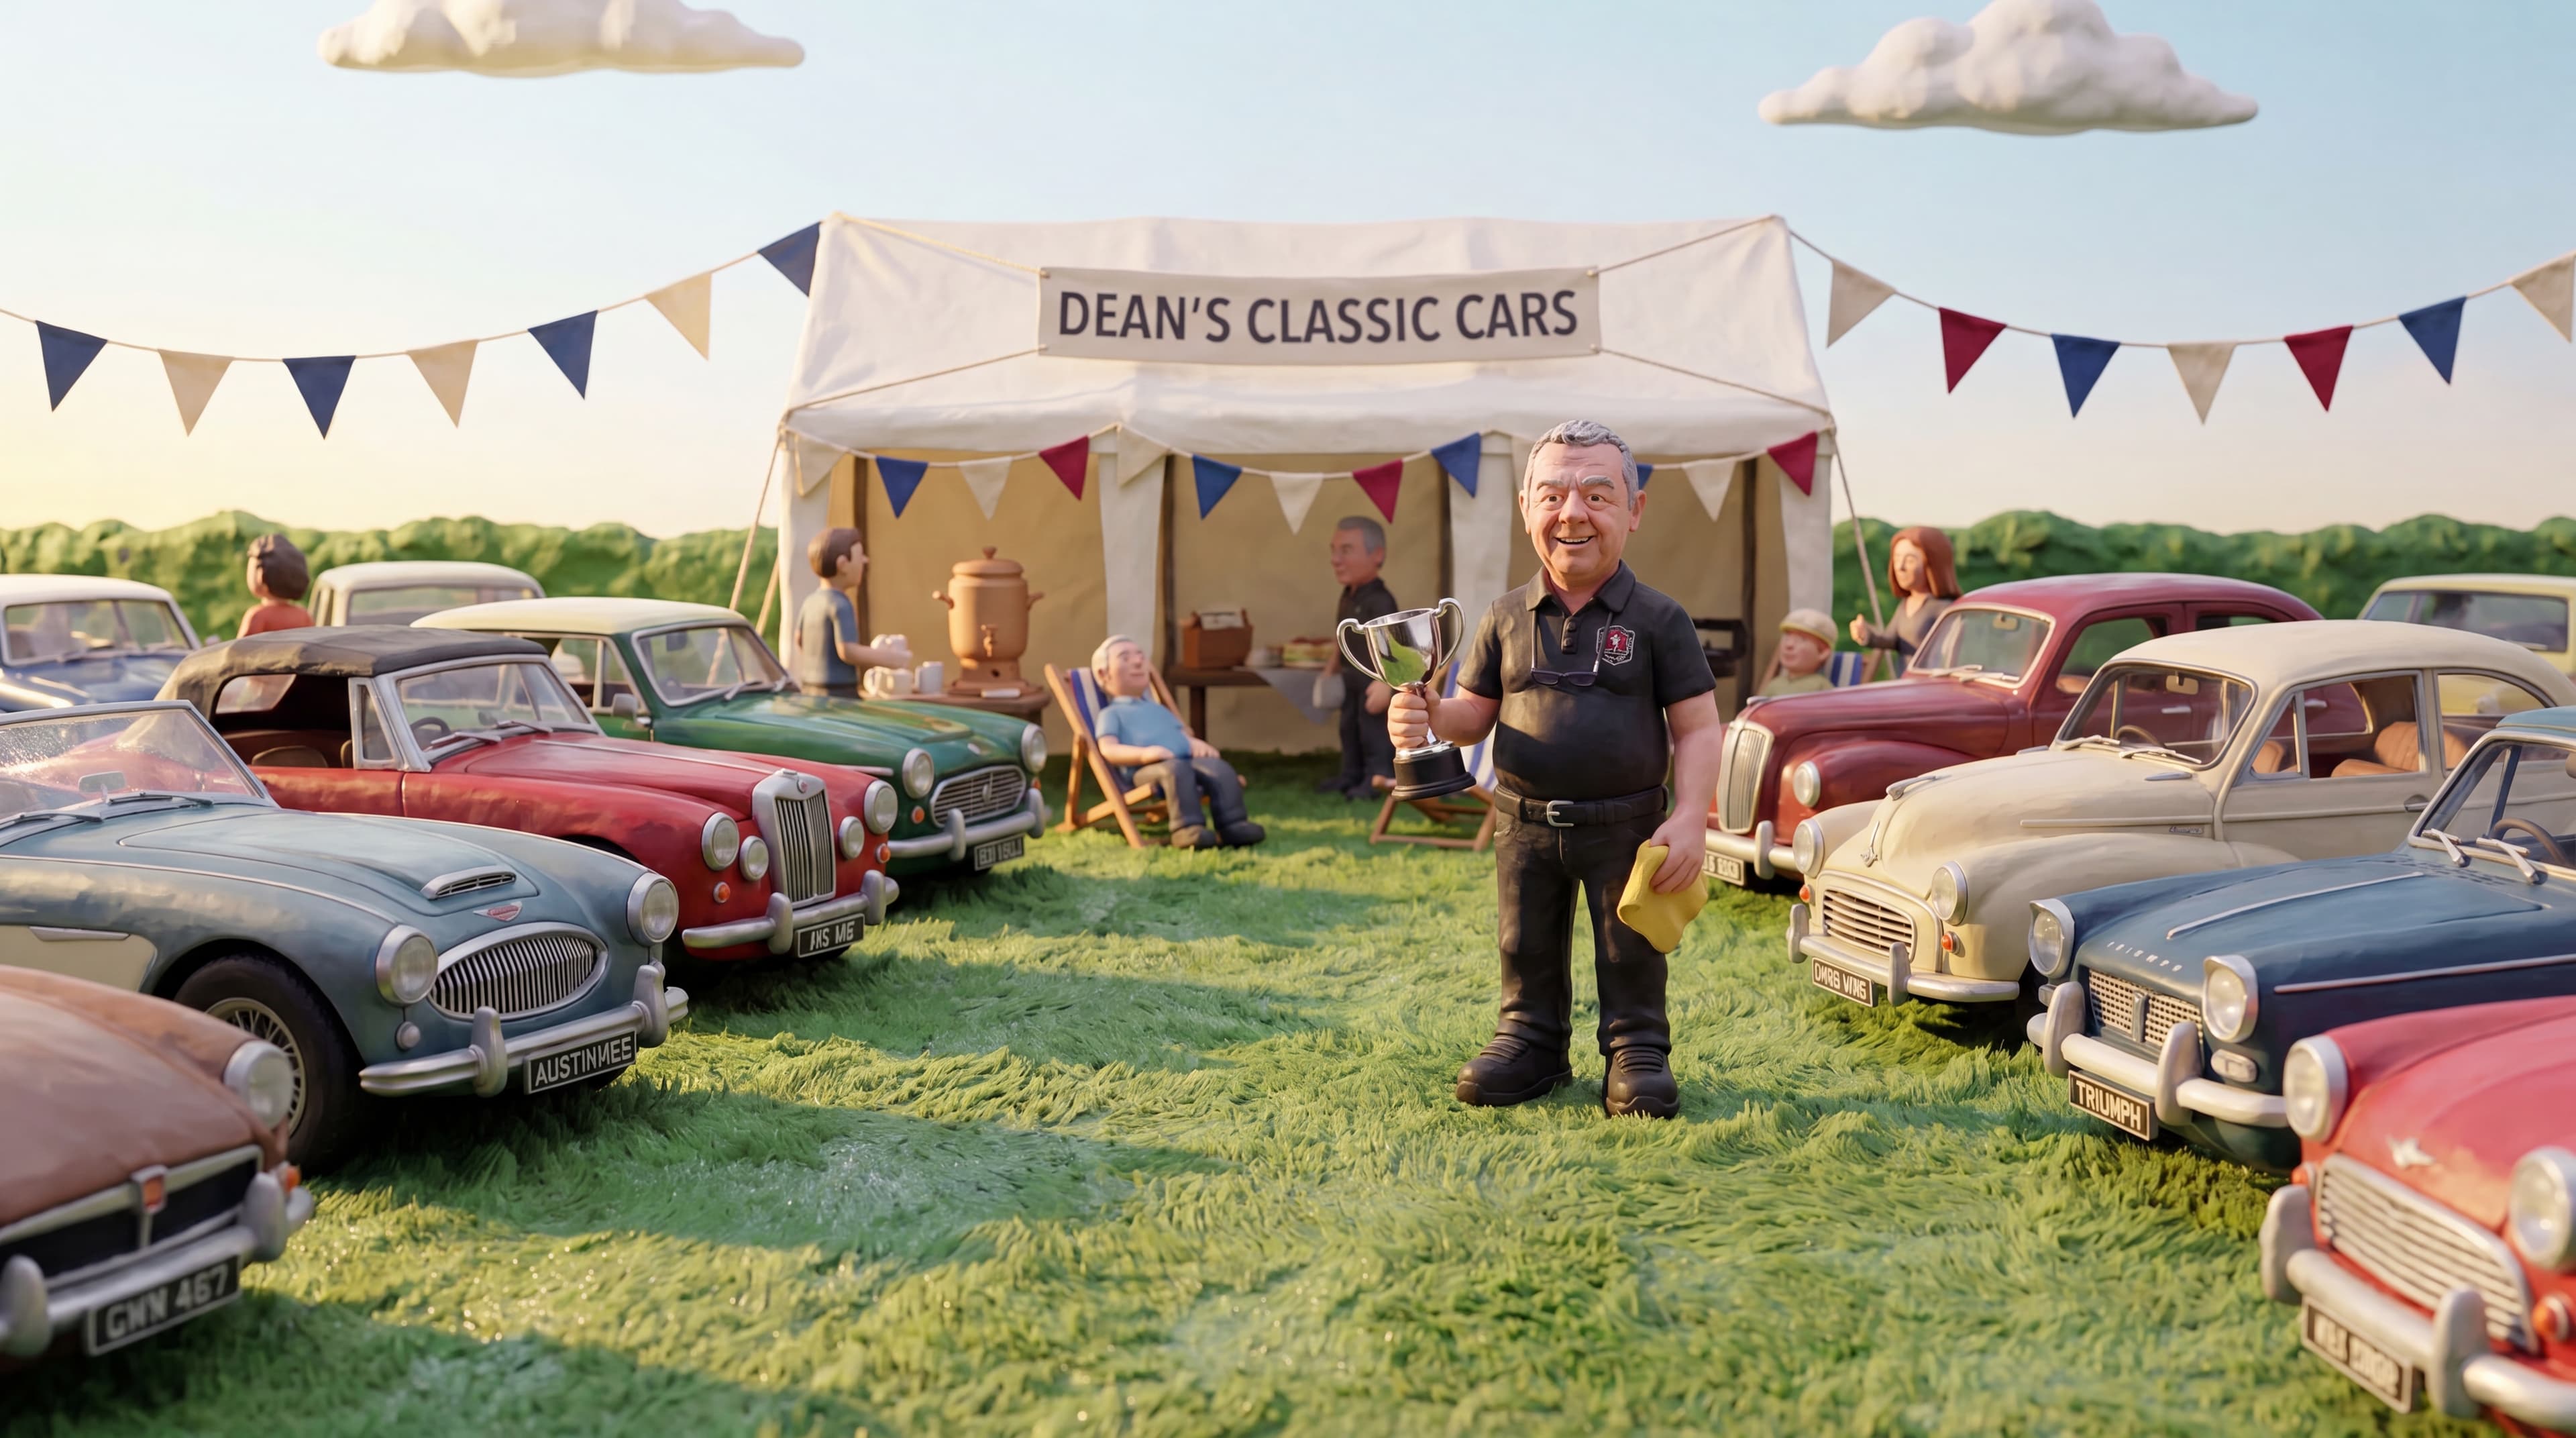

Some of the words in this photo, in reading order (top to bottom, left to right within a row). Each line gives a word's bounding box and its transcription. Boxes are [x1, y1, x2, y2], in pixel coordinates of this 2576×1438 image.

[1059, 291, 1231, 342] DEAN'S
[1247, 297, 1441, 344] CLASSIC
[1455, 289, 1578, 339] CARS
[2076, 1080, 2141, 1131] TRIUMPH
[174, 1264, 229, 1309] 467
